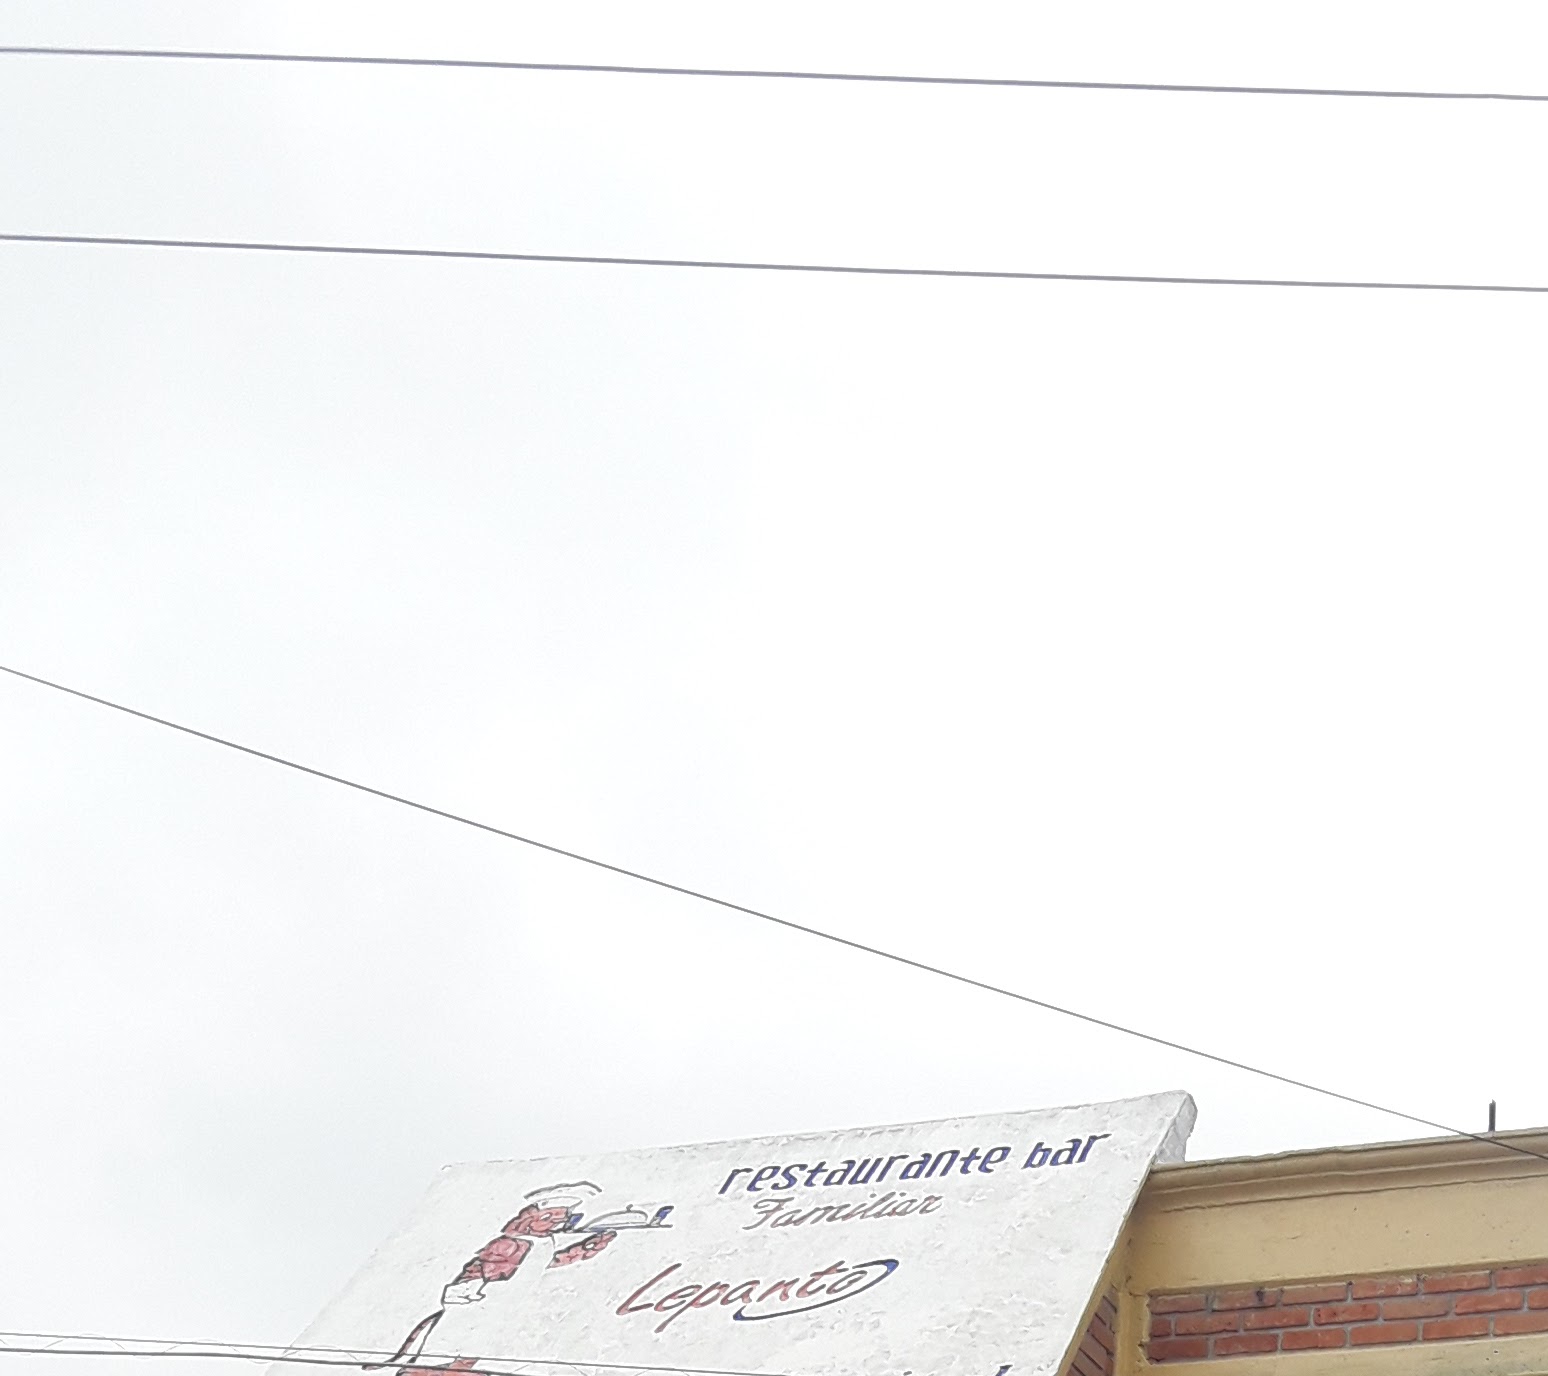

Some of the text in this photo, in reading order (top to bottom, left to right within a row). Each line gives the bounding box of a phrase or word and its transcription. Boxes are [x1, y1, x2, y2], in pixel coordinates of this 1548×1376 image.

[718, 1133, 1112, 1194] restaurante bar
[742, 1191, 943, 1230] Familiar
[616, 1261, 868, 1334] Lepanto
